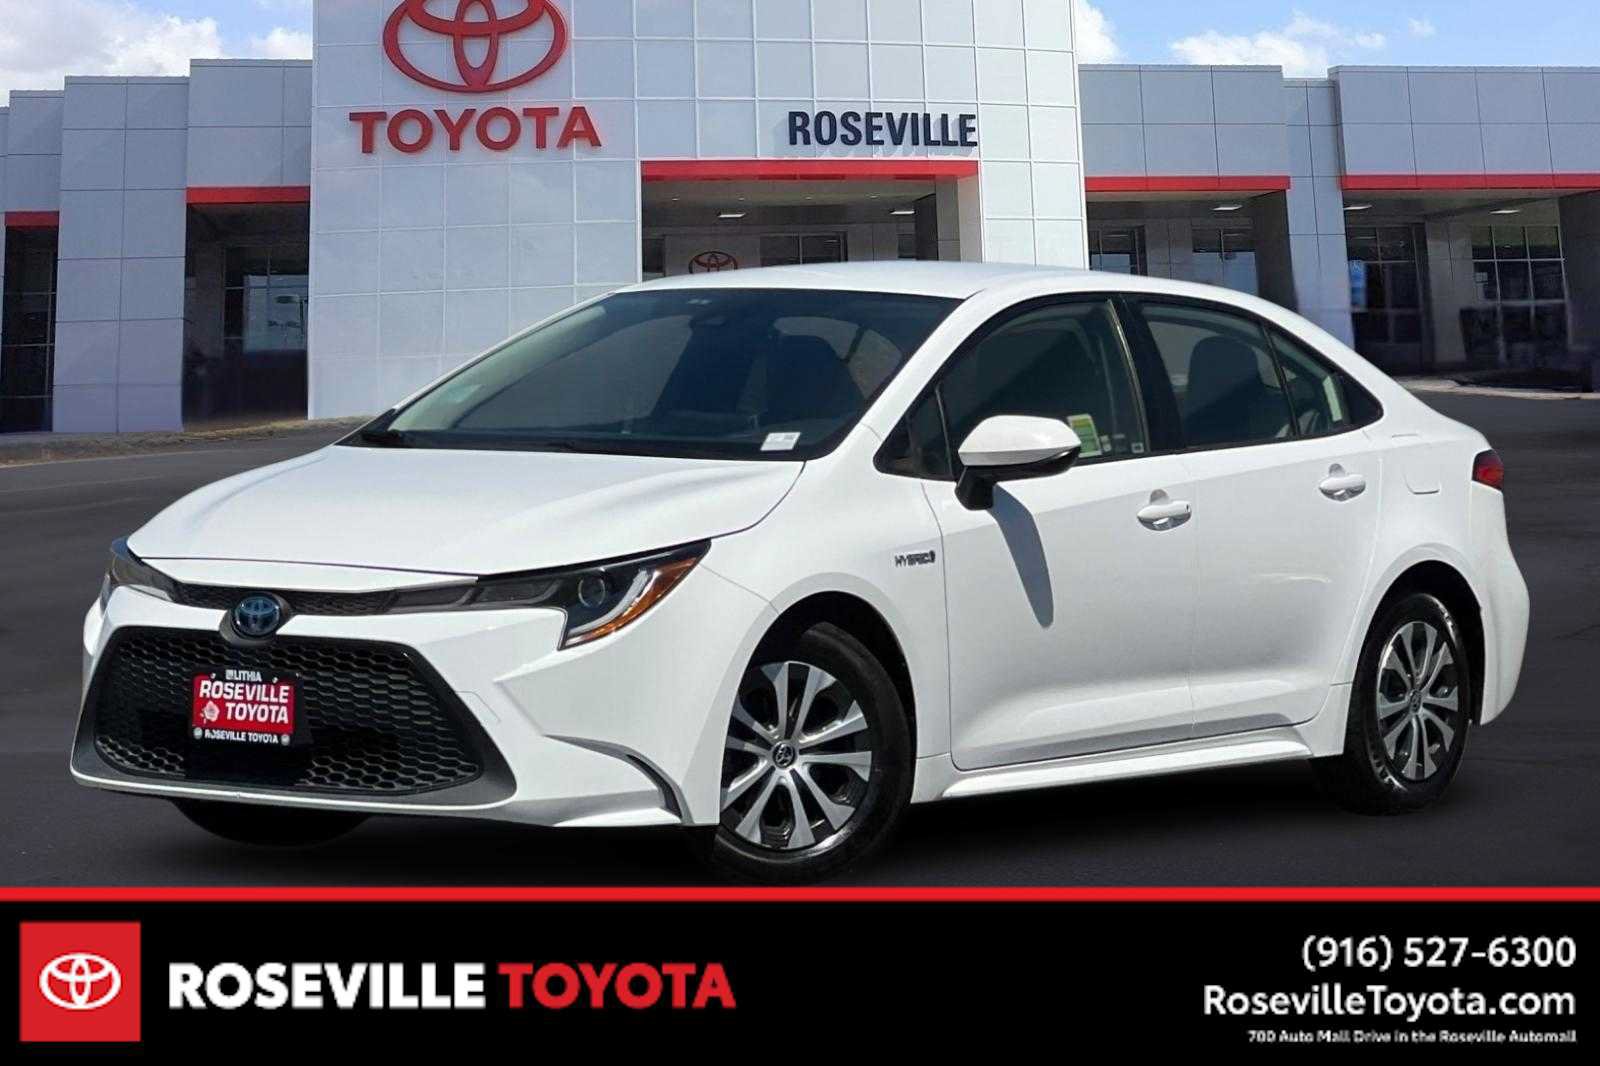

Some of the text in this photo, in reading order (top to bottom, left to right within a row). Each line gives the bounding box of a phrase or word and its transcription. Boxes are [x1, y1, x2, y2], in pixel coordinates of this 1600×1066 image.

[349, 106, 603, 154] TOYOTA
[788, 111, 979, 147] ROSEVILLE
[233, 670, 262, 682] LITHIA
[199, 680, 290, 703] ROSEVILLE
[225, 702, 289, 724] TOYOTA
[204, 729, 279, 744] ROSEVILLE TOYOTA
